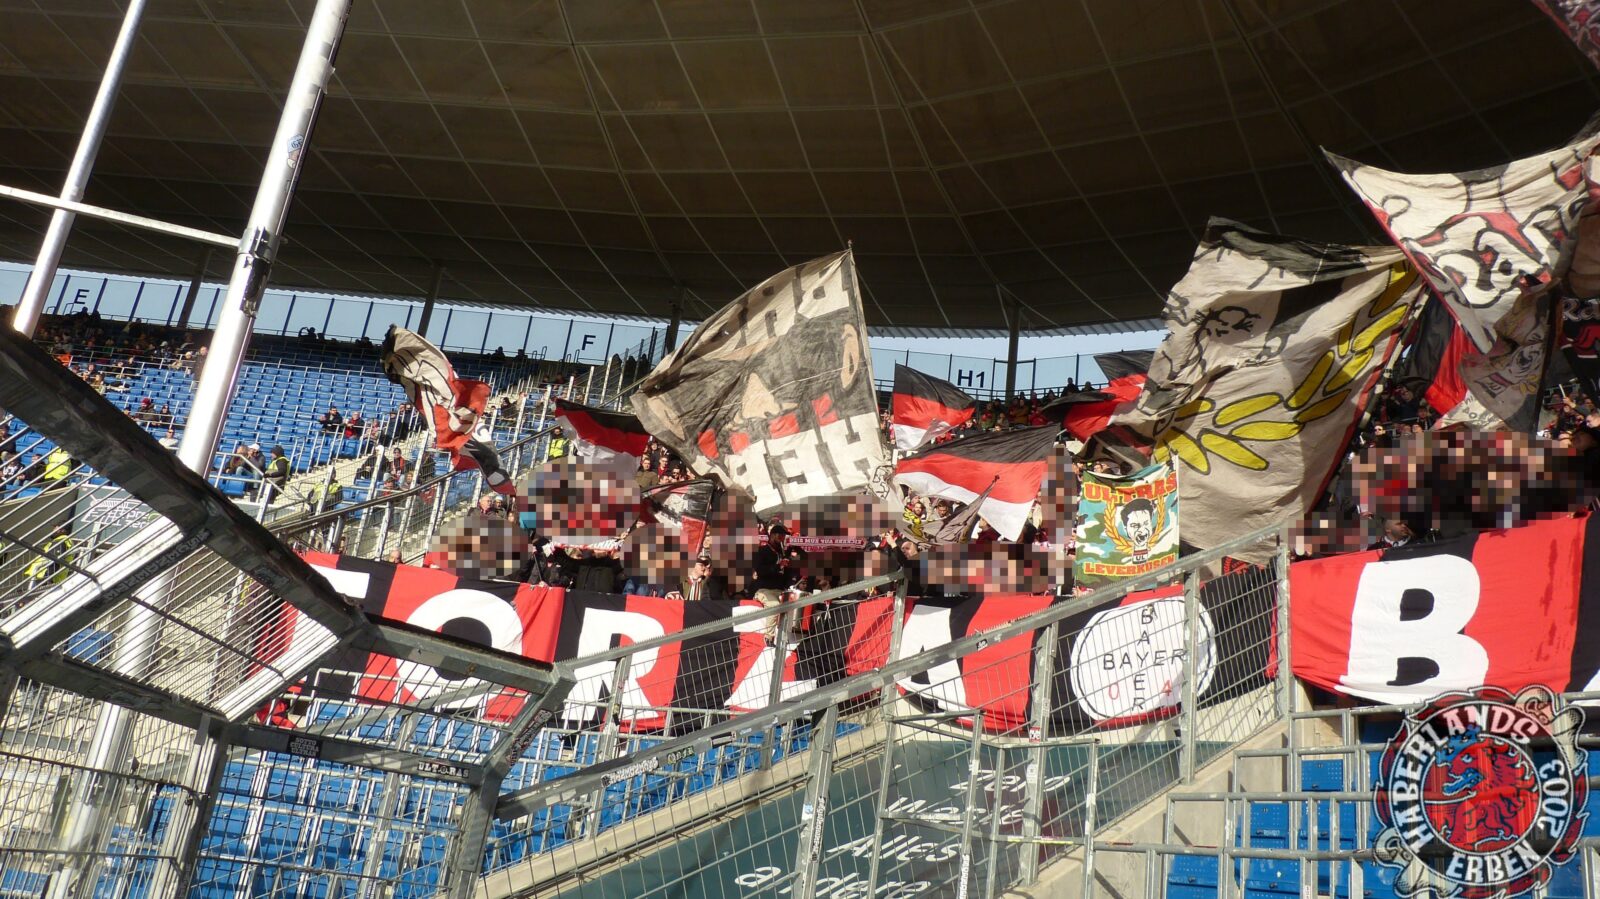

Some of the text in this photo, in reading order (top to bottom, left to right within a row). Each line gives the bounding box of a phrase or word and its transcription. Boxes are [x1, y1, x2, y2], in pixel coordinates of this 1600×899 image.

[74, 288, 90, 305] E
[581, 334, 597, 351] F
[957, 368, 985, 388] H1
[1083, 471, 1178, 504] ULTRAS
[1083, 553, 1177, 577] LEVERKUSEN
[1102, 647, 1188, 671] BAYER
[1130, 602, 1157, 712] BAYER
[826, 834, 964, 862] Alles
[735, 866, 932, 899] adere
